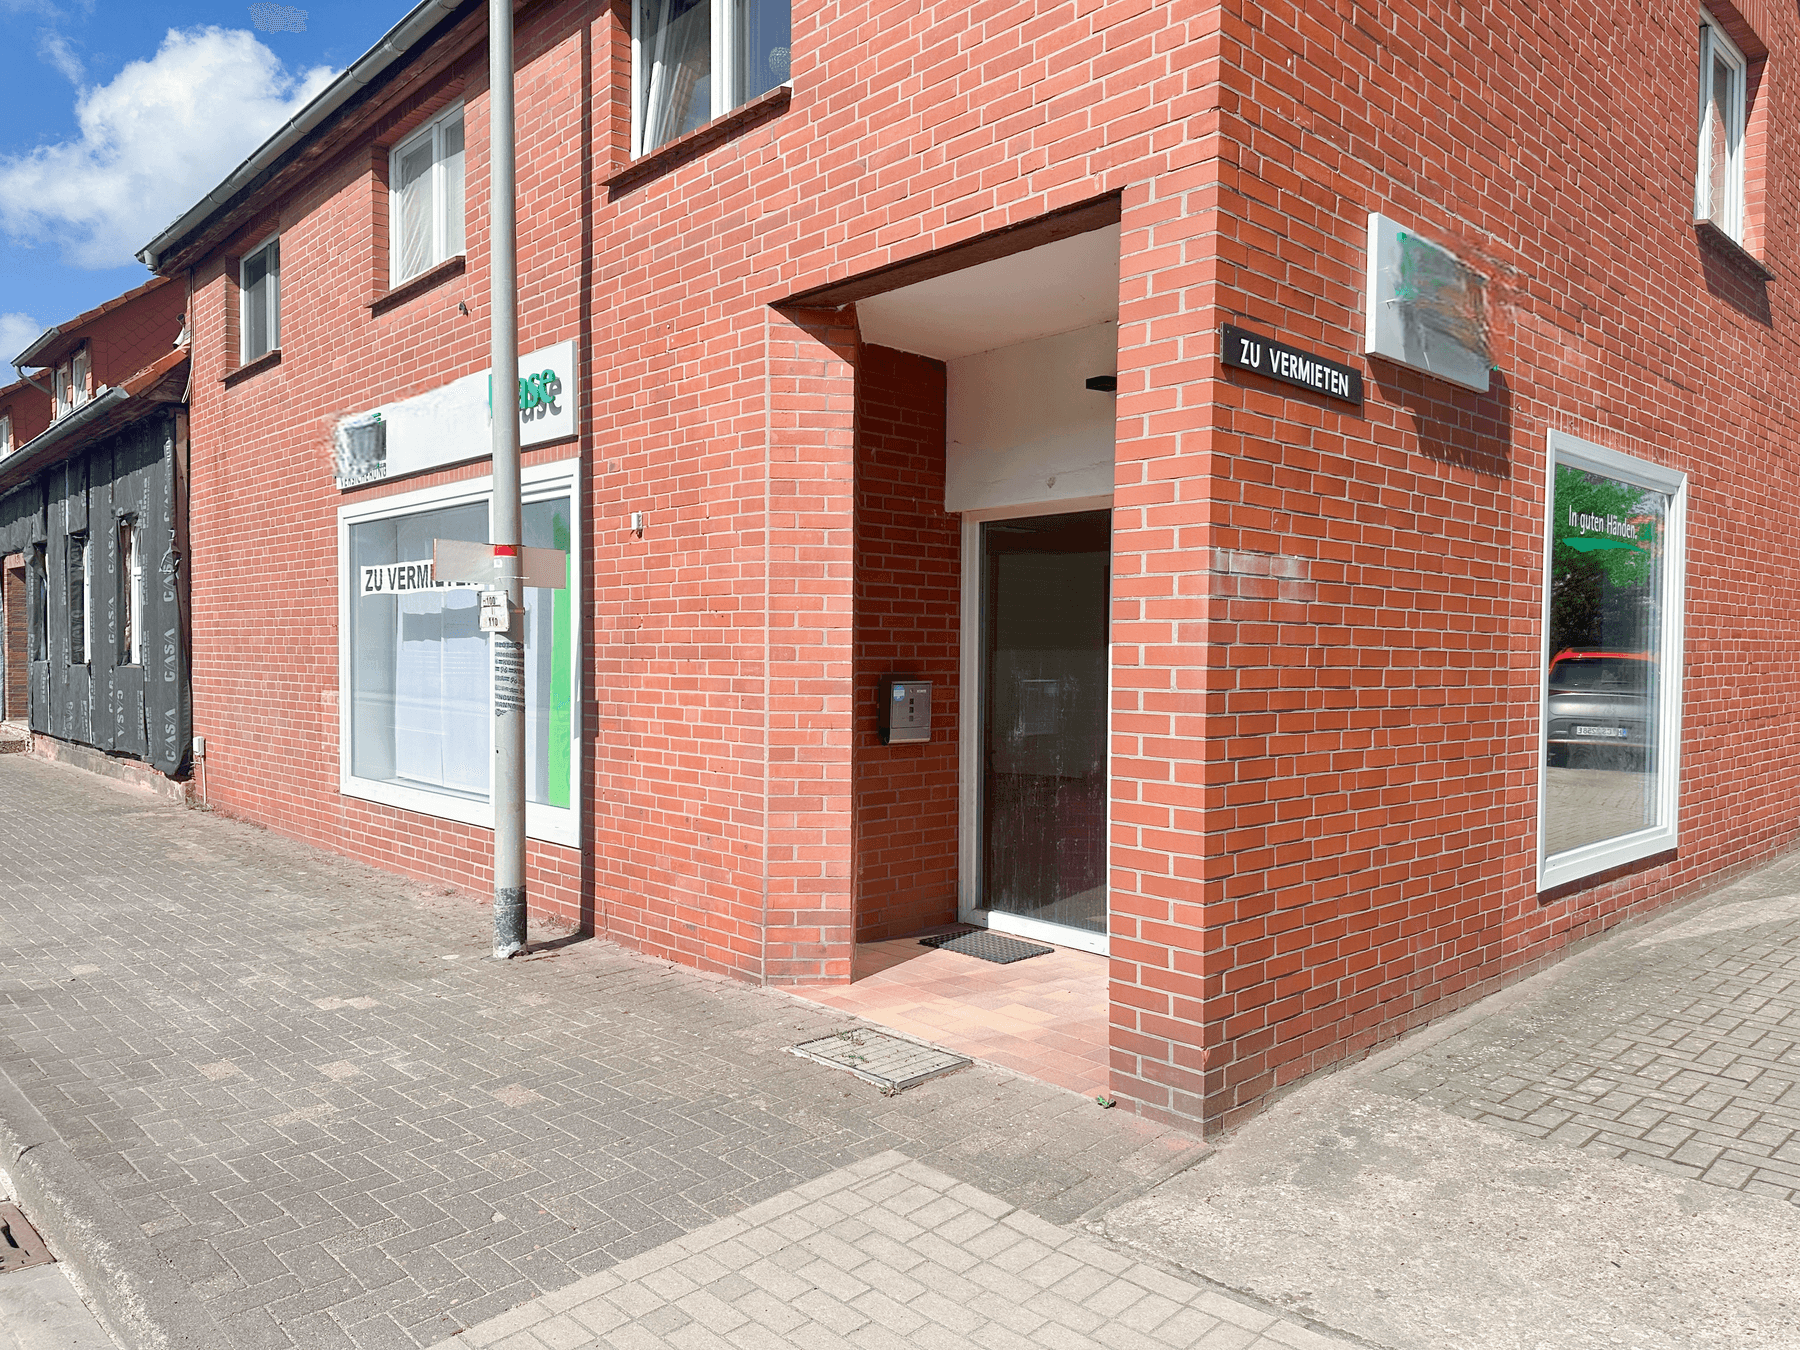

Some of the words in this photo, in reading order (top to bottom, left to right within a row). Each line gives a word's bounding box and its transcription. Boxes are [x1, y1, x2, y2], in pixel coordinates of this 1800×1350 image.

[1240, 338, 1260, 368] ZU
[1269, 347, 1349, 398] VERMIETEN
[1568, 504, 1577, 527] In
[1580, 512, 1604, 535] guten
[1607, 513, 1638, 539] Händen.
[365, 569, 383, 592] ZU
[163, 628, 176, 682] CASA
[163, 708, 177, 762] CASA
